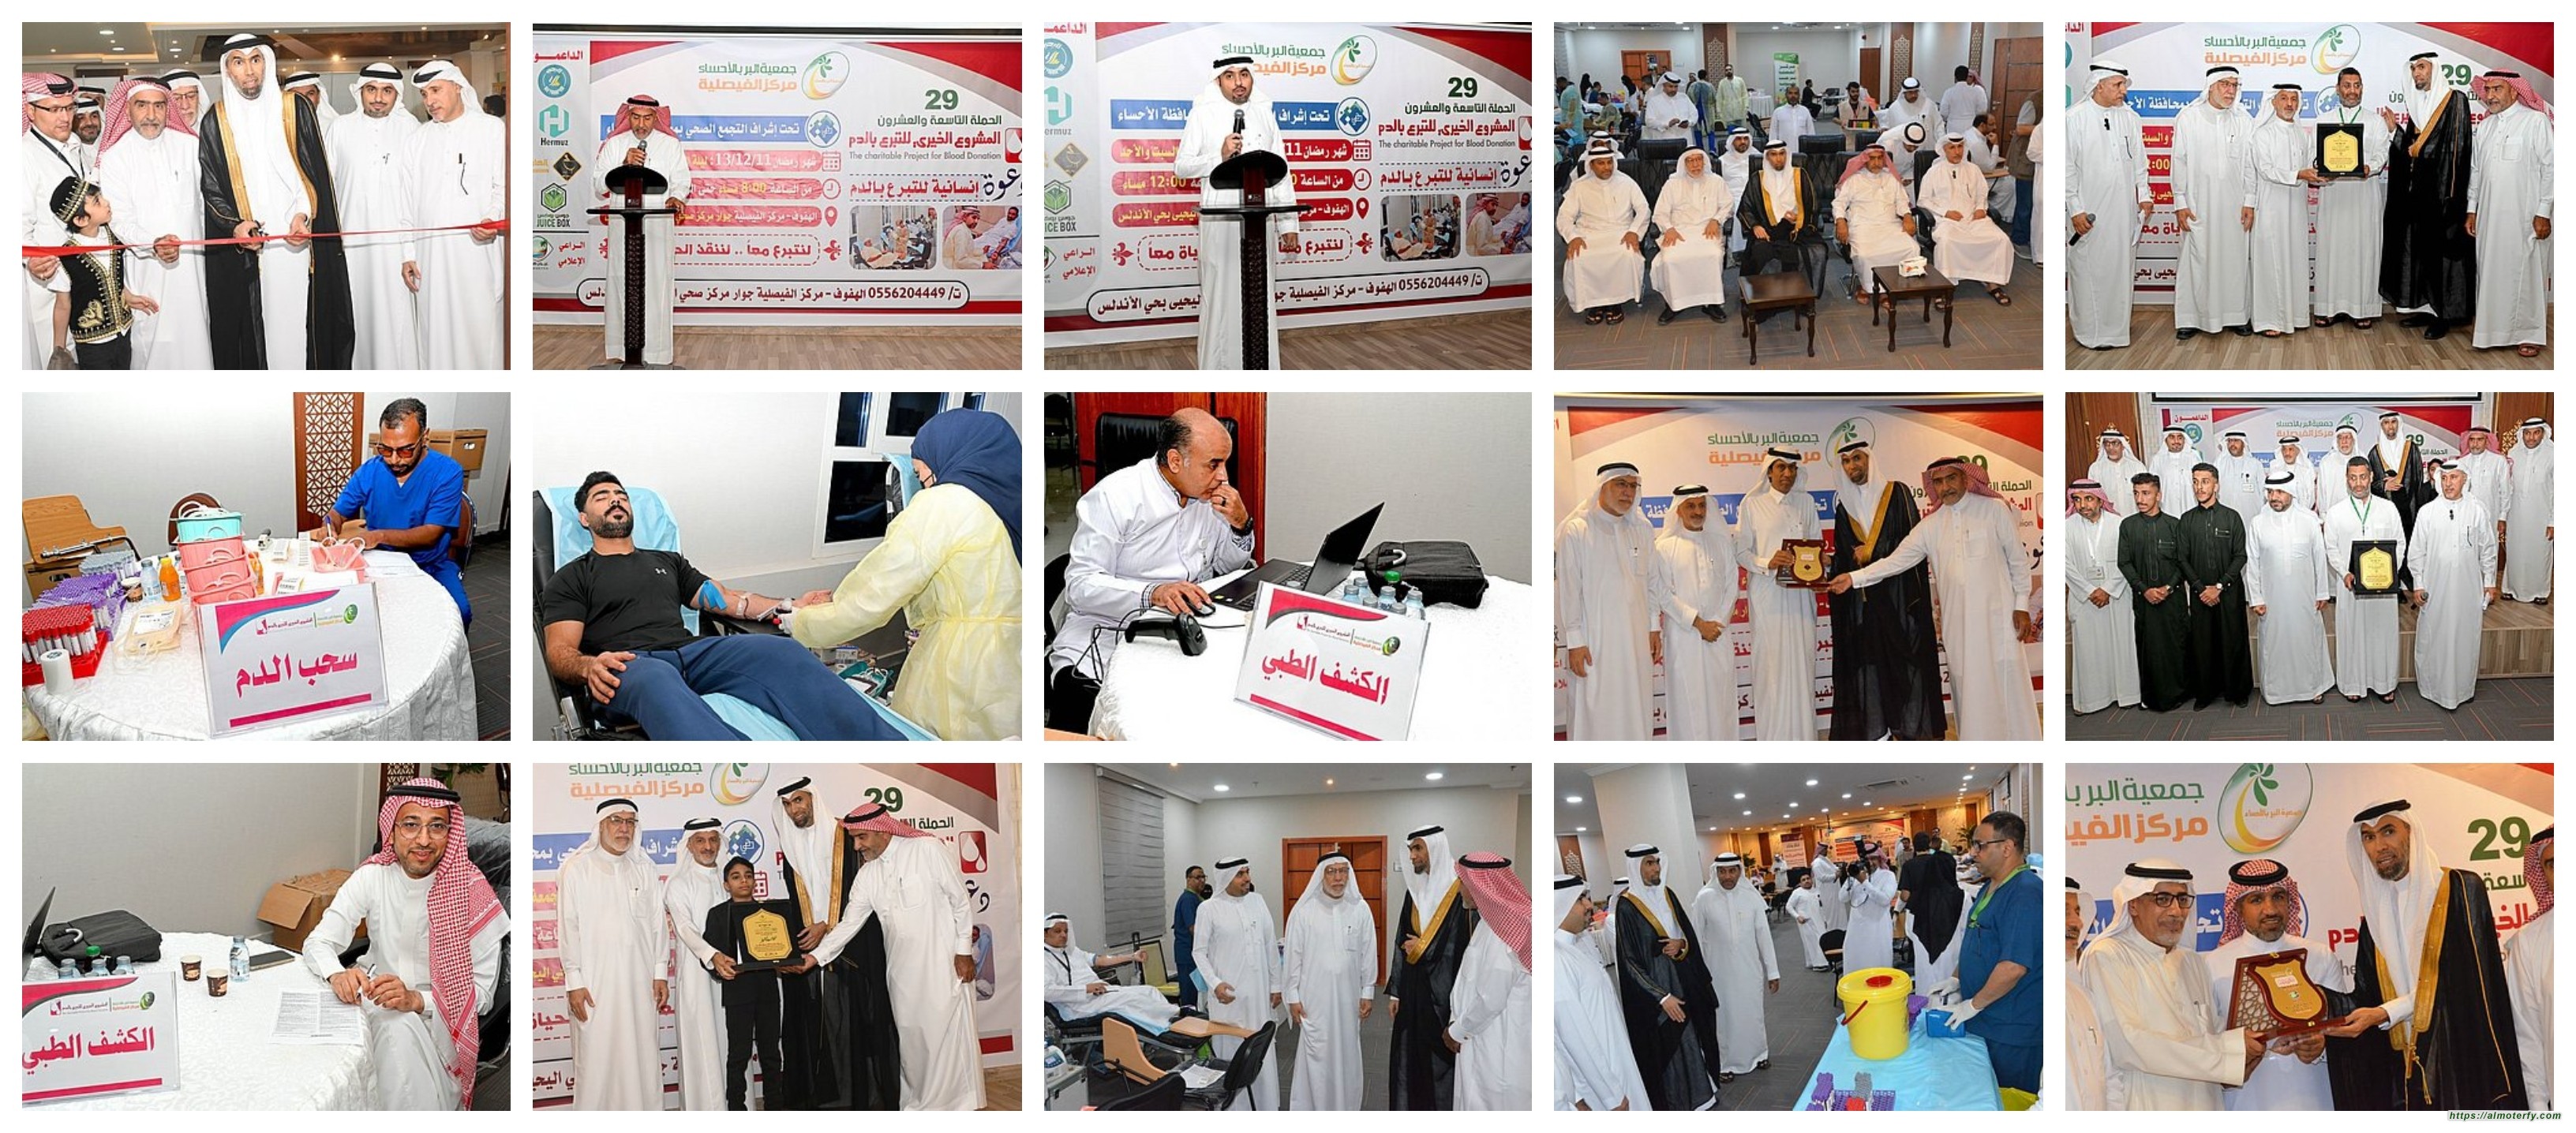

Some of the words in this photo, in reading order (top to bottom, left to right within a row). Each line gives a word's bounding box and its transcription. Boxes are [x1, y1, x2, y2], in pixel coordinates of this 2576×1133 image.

[2204, 35, 2251, 50] بالأحساء
[2252, 36, 2267, 50] البر
[2268, 35, 2307, 49] جمعية
[534, 49, 583, 63] الداعمو
[1221, 42, 1270, 58] بالأحساء
[1271, 45, 1287, 58] البر
[1288, 44, 1326, 59] جمعية
[2204, 51, 2271, 67] الفيصلية
[2271, 52, 2307, 67] مركز
[698, 62, 743, 75] بالأحساء
[743, 63, 759, 76] البر
[760, 62, 797, 75] جمعية
[1291, 61, 1327, 77] مركز
[698, 78, 761, 92] الفيصلية
[762, 78, 797, 92] مركز
[1447, 77, 1478, 99] 29
[925, 89, 959, 110] 29
[1118, 106, 1159, 123] الأحساء
[1309, 110, 1331, 122] تحت
[1405, 102, 1451, 115] والعشرون
[1452, 103, 1488, 114] التاسعة
[1488, 103, 1516, 114] الحملة
[878, 114, 927, 127] والعشرون
[930, 114, 968, 125] التاسعة
[971, 114, 1002, 125] الحملة
[686, 122, 716, 136] الصحي
[717, 122, 747, 136] التجمع
[780, 123, 799, 134] تحت
[1378, 119, 1405, 136] بالدم
[1406, 120, 1437, 136] للتبرع
[1475, 120, 1515, 136] المشروع
[541, 136, 569, 146] Hermuz
[849, 131, 878, 148] بالدم
[878, 131, 911, 148] للتبرع
[954, 132, 1001, 148] المشروع
[1379, 140, 1391, 148] The
[1393, 140, 1428, 148] charitable
[1430, 140, 1454, 150] Project
[1455, 140, 1466, 148] for
[1466, 139, 1485, 148] Blood
[1486, 139, 1515, 148] Donation
[904, 151, 929, 162] Project
[967, 151, 1002, 160] Donation
[1303, 144, 1330, 159] رمضان
[1332, 144, 1347, 159] شهر
[802, 157, 818, 167] شهر
[1150, 174, 1187, 189] 12:00
[1300, 173, 1331, 186] الساعة
[1332, 174, 1344, 189] من
[1380, 169, 1413, 187] بالدم
[1416, 169, 1452, 187] للتبرع
[1456, 167, 1497, 185] إنسانية
[800, 185, 813, 196] من
[849, 181, 884, 196] بالدم
[887, 180, 929, 197] للتبرع
[933, 180, 979, 198] إنسانية
[734, 210, 765, 222] الفيصلية
[766, 211, 785, 222] مركز
[1118, 208, 1152, 223] الأندلس
[1153, 210, 1171, 224] بحي
[1324, 204, 1350, 216] الهفوف
[537, 219, 555, 227] JUICE
[557, 219, 571, 227] BOX
[791, 212, 818, 224] الهفوف
[1044, 222, 1059, 233] ICE
[1060, 222, 1076, 232] BOX
[558, 241, 586, 252] الراعي
[696, 242, 731, 256] لننقذ
[772, 241, 811, 260] لنتبرع
[1063, 247, 1096, 261] الراعي
[1305, 239, 1344, 256] لنتبرع
[557, 256, 586, 268] الإعلامي
[1061, 264, 1096, 279] الإعلامي
[1332, 283, 1357, 299] مركز
[1365, 282, 1398, 297] الهفوف
[1398, 275, 1470, 292] 0556204449
[679, 290, 703, 301] صحي
[707, 288, 730, 301] مركز
[733, 289, 754, 300] جوار
[757, 287, 797, 302] الفيصلية
[799, 287, 823, 301] مركز
[833, 288, 867, 301] الهفوف
[868, 286, 945, 299] 0556204449
[1289, 284, 1331, 301] الفيصلية
[1097, 296, 1142, 315] الأندلس
[1144, 296, 1167, 313] بحي
[1708, 430, 1759, 447] بالأحساء
[1761, 432, 1777, 447] البر
[1778, 431, 1820, 446] جمعية
[2001, 480, 2032, 492] الحملة
[298, 653, 358, 686] سحب
[1262, 649, 1317, 682] الطبي
[236, 653, 292, 698] الدم
[1320, 662, 1390, 705] الكشف
[570, 780, 659, 800] الفيصلية
[659, 780, 705, 798] مركز
[2085, 780, 2120, 806] البر
[2123, 777, 2204, 805] جمعية
[918, 817, 954, 829] الحملة
[2133, 812, 2208, 843] مركز
[2467, 816, 2531, 862] 29
[2341, 959, 2357, 976] he
[87, 1026, 155, 1056] الكشف
[22, 1032, 82, 1075] الطبي
